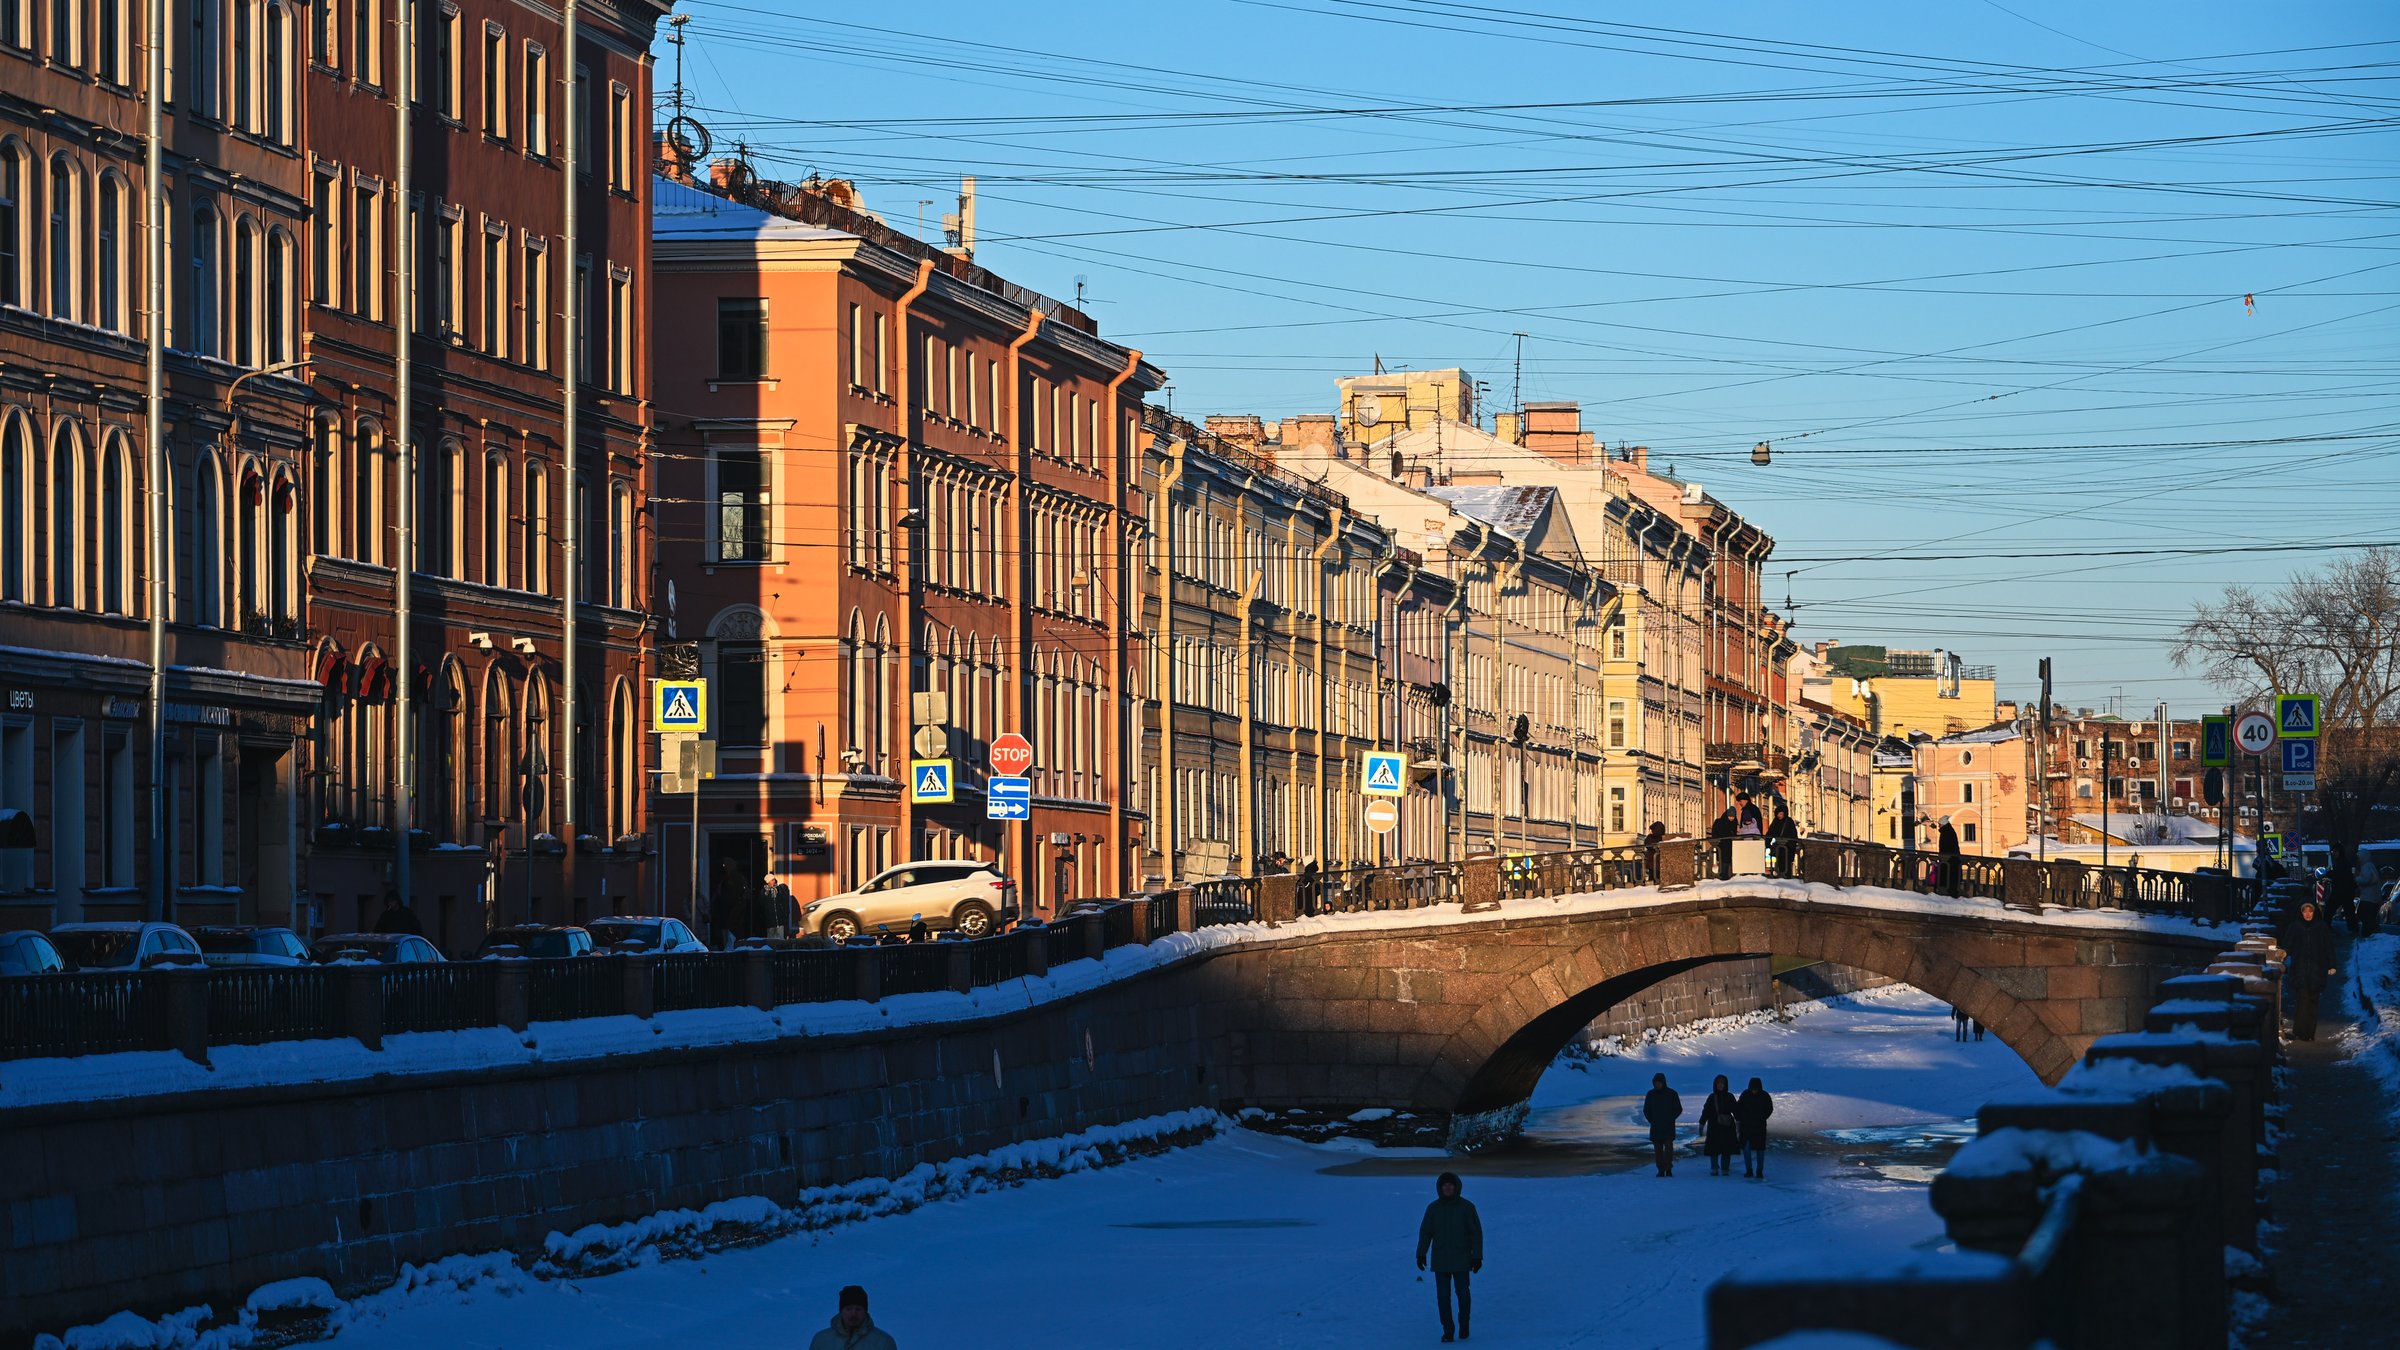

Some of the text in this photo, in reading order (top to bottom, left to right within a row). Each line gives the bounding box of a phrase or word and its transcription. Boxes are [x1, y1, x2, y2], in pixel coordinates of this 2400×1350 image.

[2243, 724, 2268, 742] 40
[993, 748, 1030, 762] STOP
[2291, 743, 2309, 769] P
